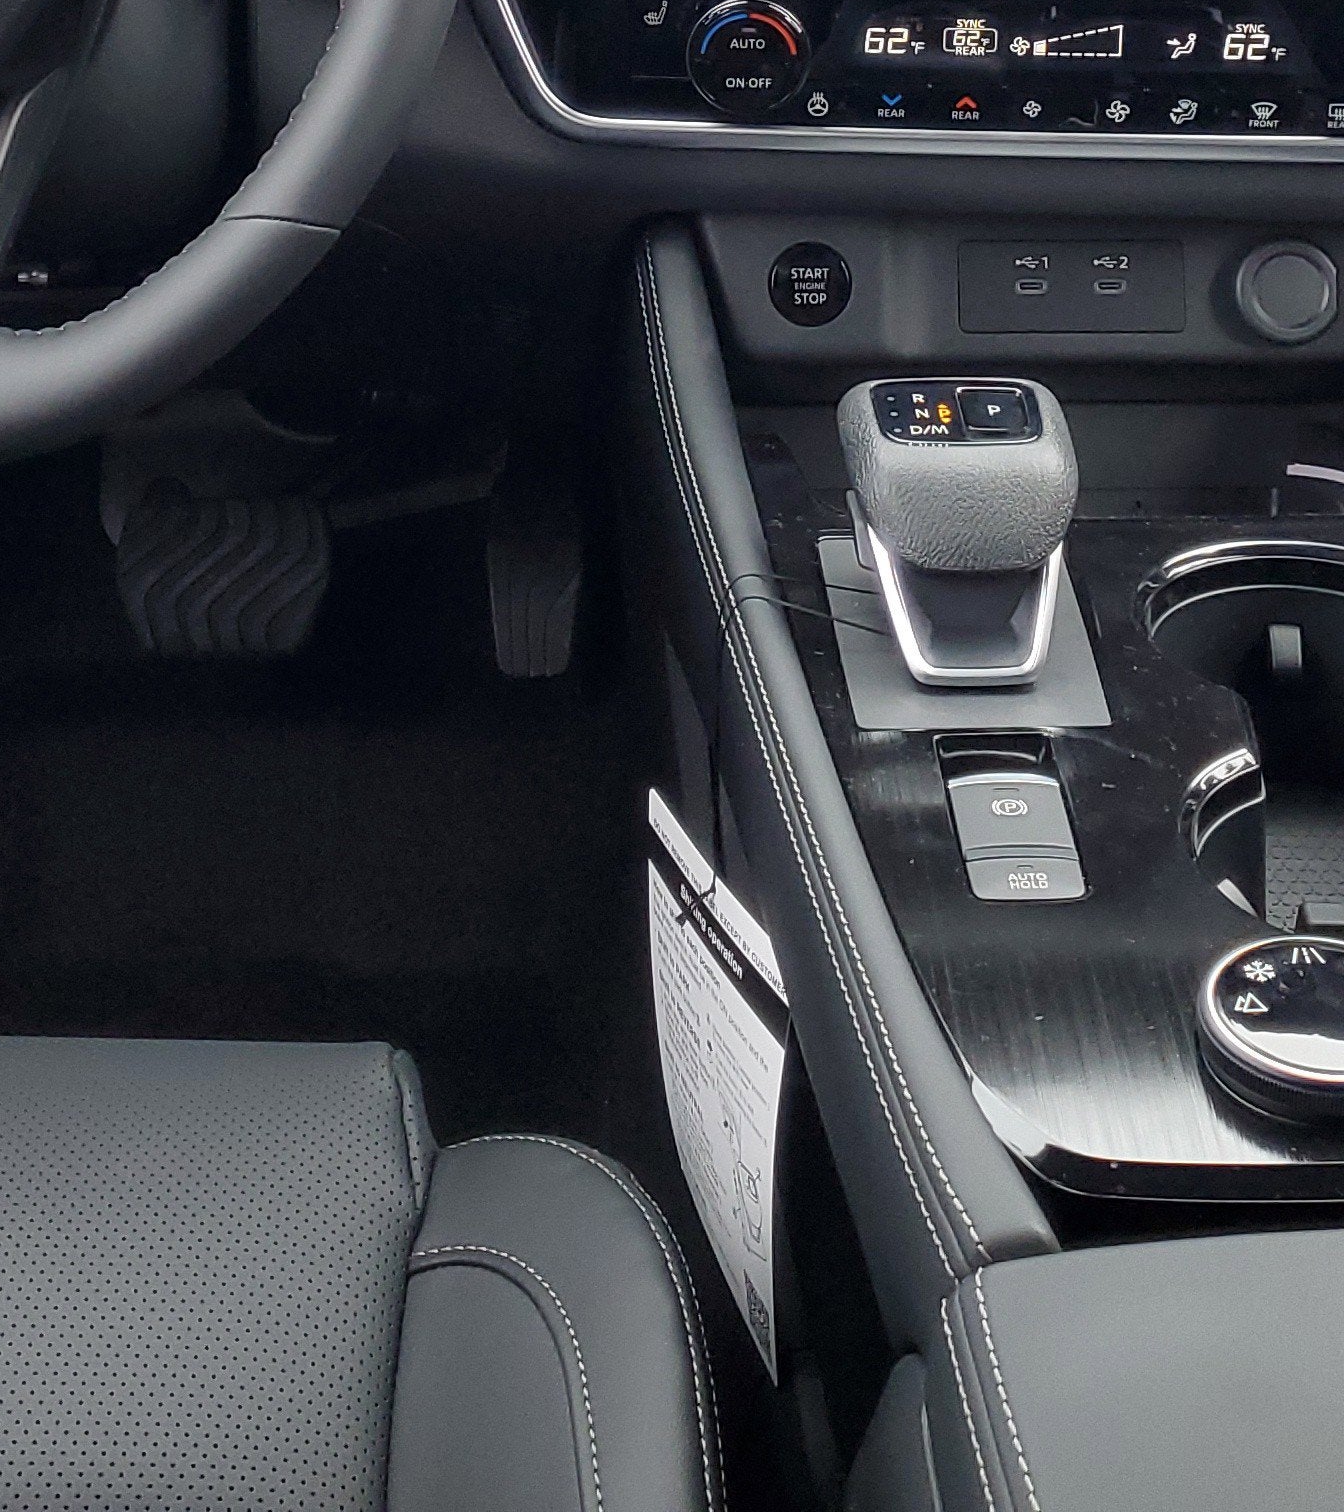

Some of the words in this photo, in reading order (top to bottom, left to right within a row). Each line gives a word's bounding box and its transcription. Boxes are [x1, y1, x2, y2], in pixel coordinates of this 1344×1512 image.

[957, 19, 986, 28] SYNC
[1236, 24, 1265, 33] SYNC
[730, 38, 766, 50] AUTO
[956, 47, 985, 55] REAR
[878, 109, 904, 118] REAR
[952, 111, 979, 120] REAR
[1249, 120, 1278, 128] FRONT
[1042, 256, 1049, 269] 1
[1119, 256, 1129, 269] 2
[791, 268, 829, 279] START
[794, 282, 826, 290] ENGINE
[794, 293, 827, 304] STOP
[912, 394, 925, 403] R
[915, 409, 929, 419] N
[988, 405, 1000, 416] P
[909, 426, 949, 435] D/M
[1008, 873, 1047, 882] AUTO
[1010, 880, 1048, 889] HOLD
[708, 927, 743, 980] operation
